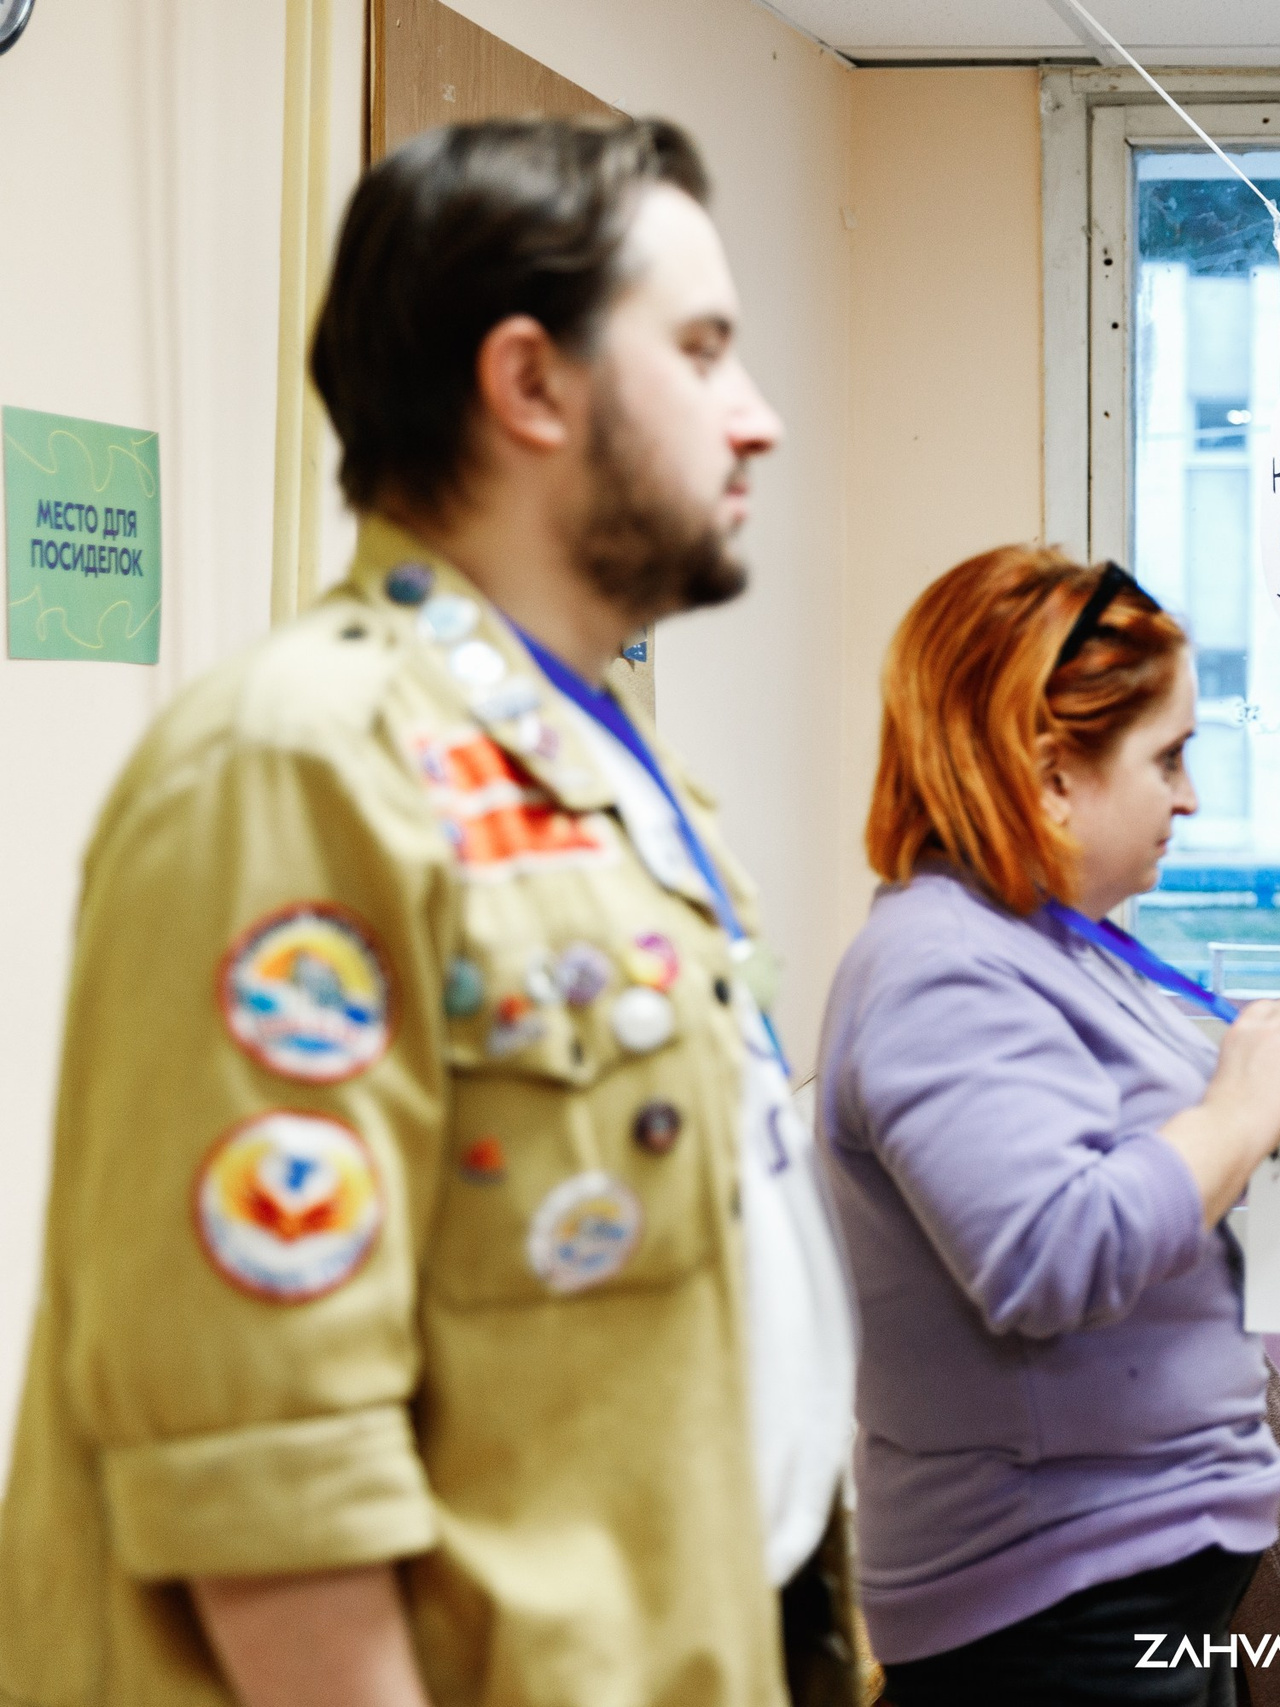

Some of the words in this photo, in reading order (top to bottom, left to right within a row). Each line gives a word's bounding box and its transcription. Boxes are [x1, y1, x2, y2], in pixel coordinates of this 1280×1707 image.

[36, 498, 98, 534] МЕСТО
[103, 507, 137, 541] ДЛЯ
[30, 538, 144, 578] ПОСИДЕЛОК
